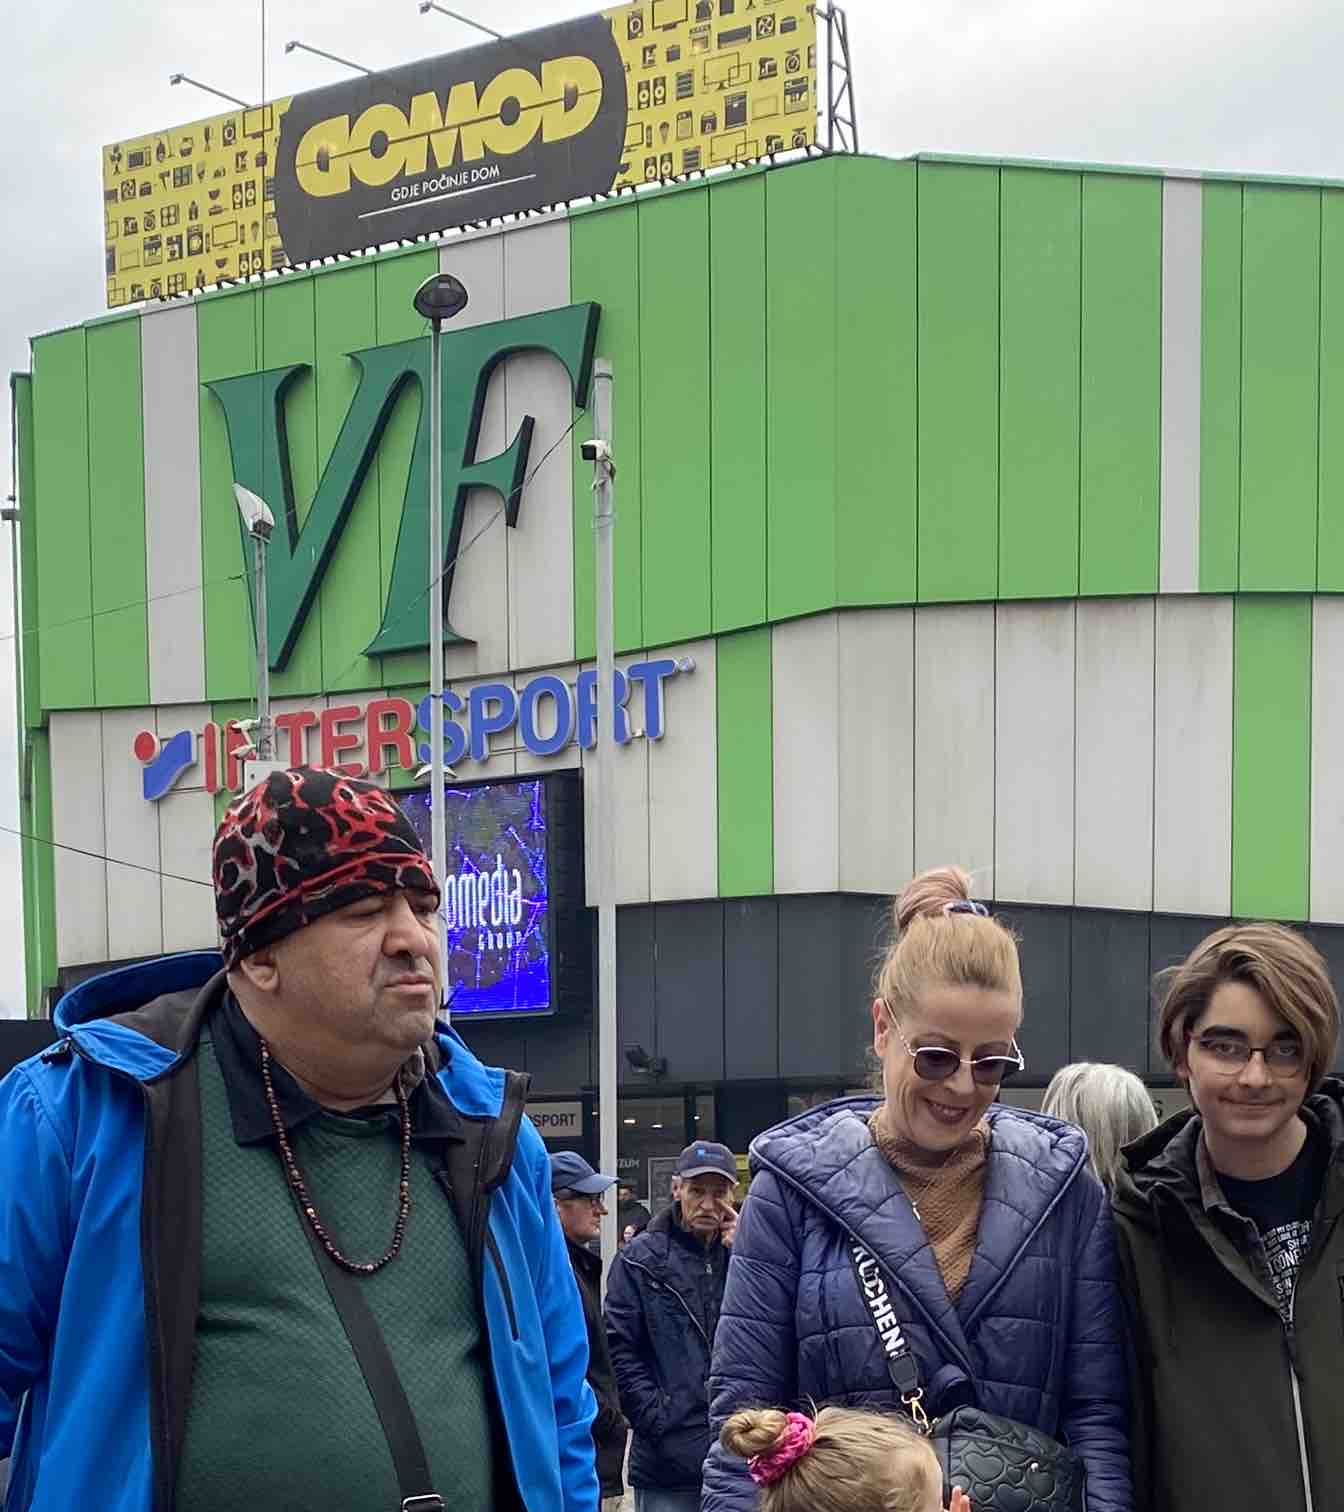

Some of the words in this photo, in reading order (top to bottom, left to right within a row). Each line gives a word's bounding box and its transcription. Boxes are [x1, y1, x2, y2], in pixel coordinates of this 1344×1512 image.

[390, 184, 421, 201] GDJE
[422, 172, 469, 194] POČINJE
[471, 164, 500, 183] DOM
[199, 300, 603, 673] VF
[529, 1112, 577, 1128] SPORT
